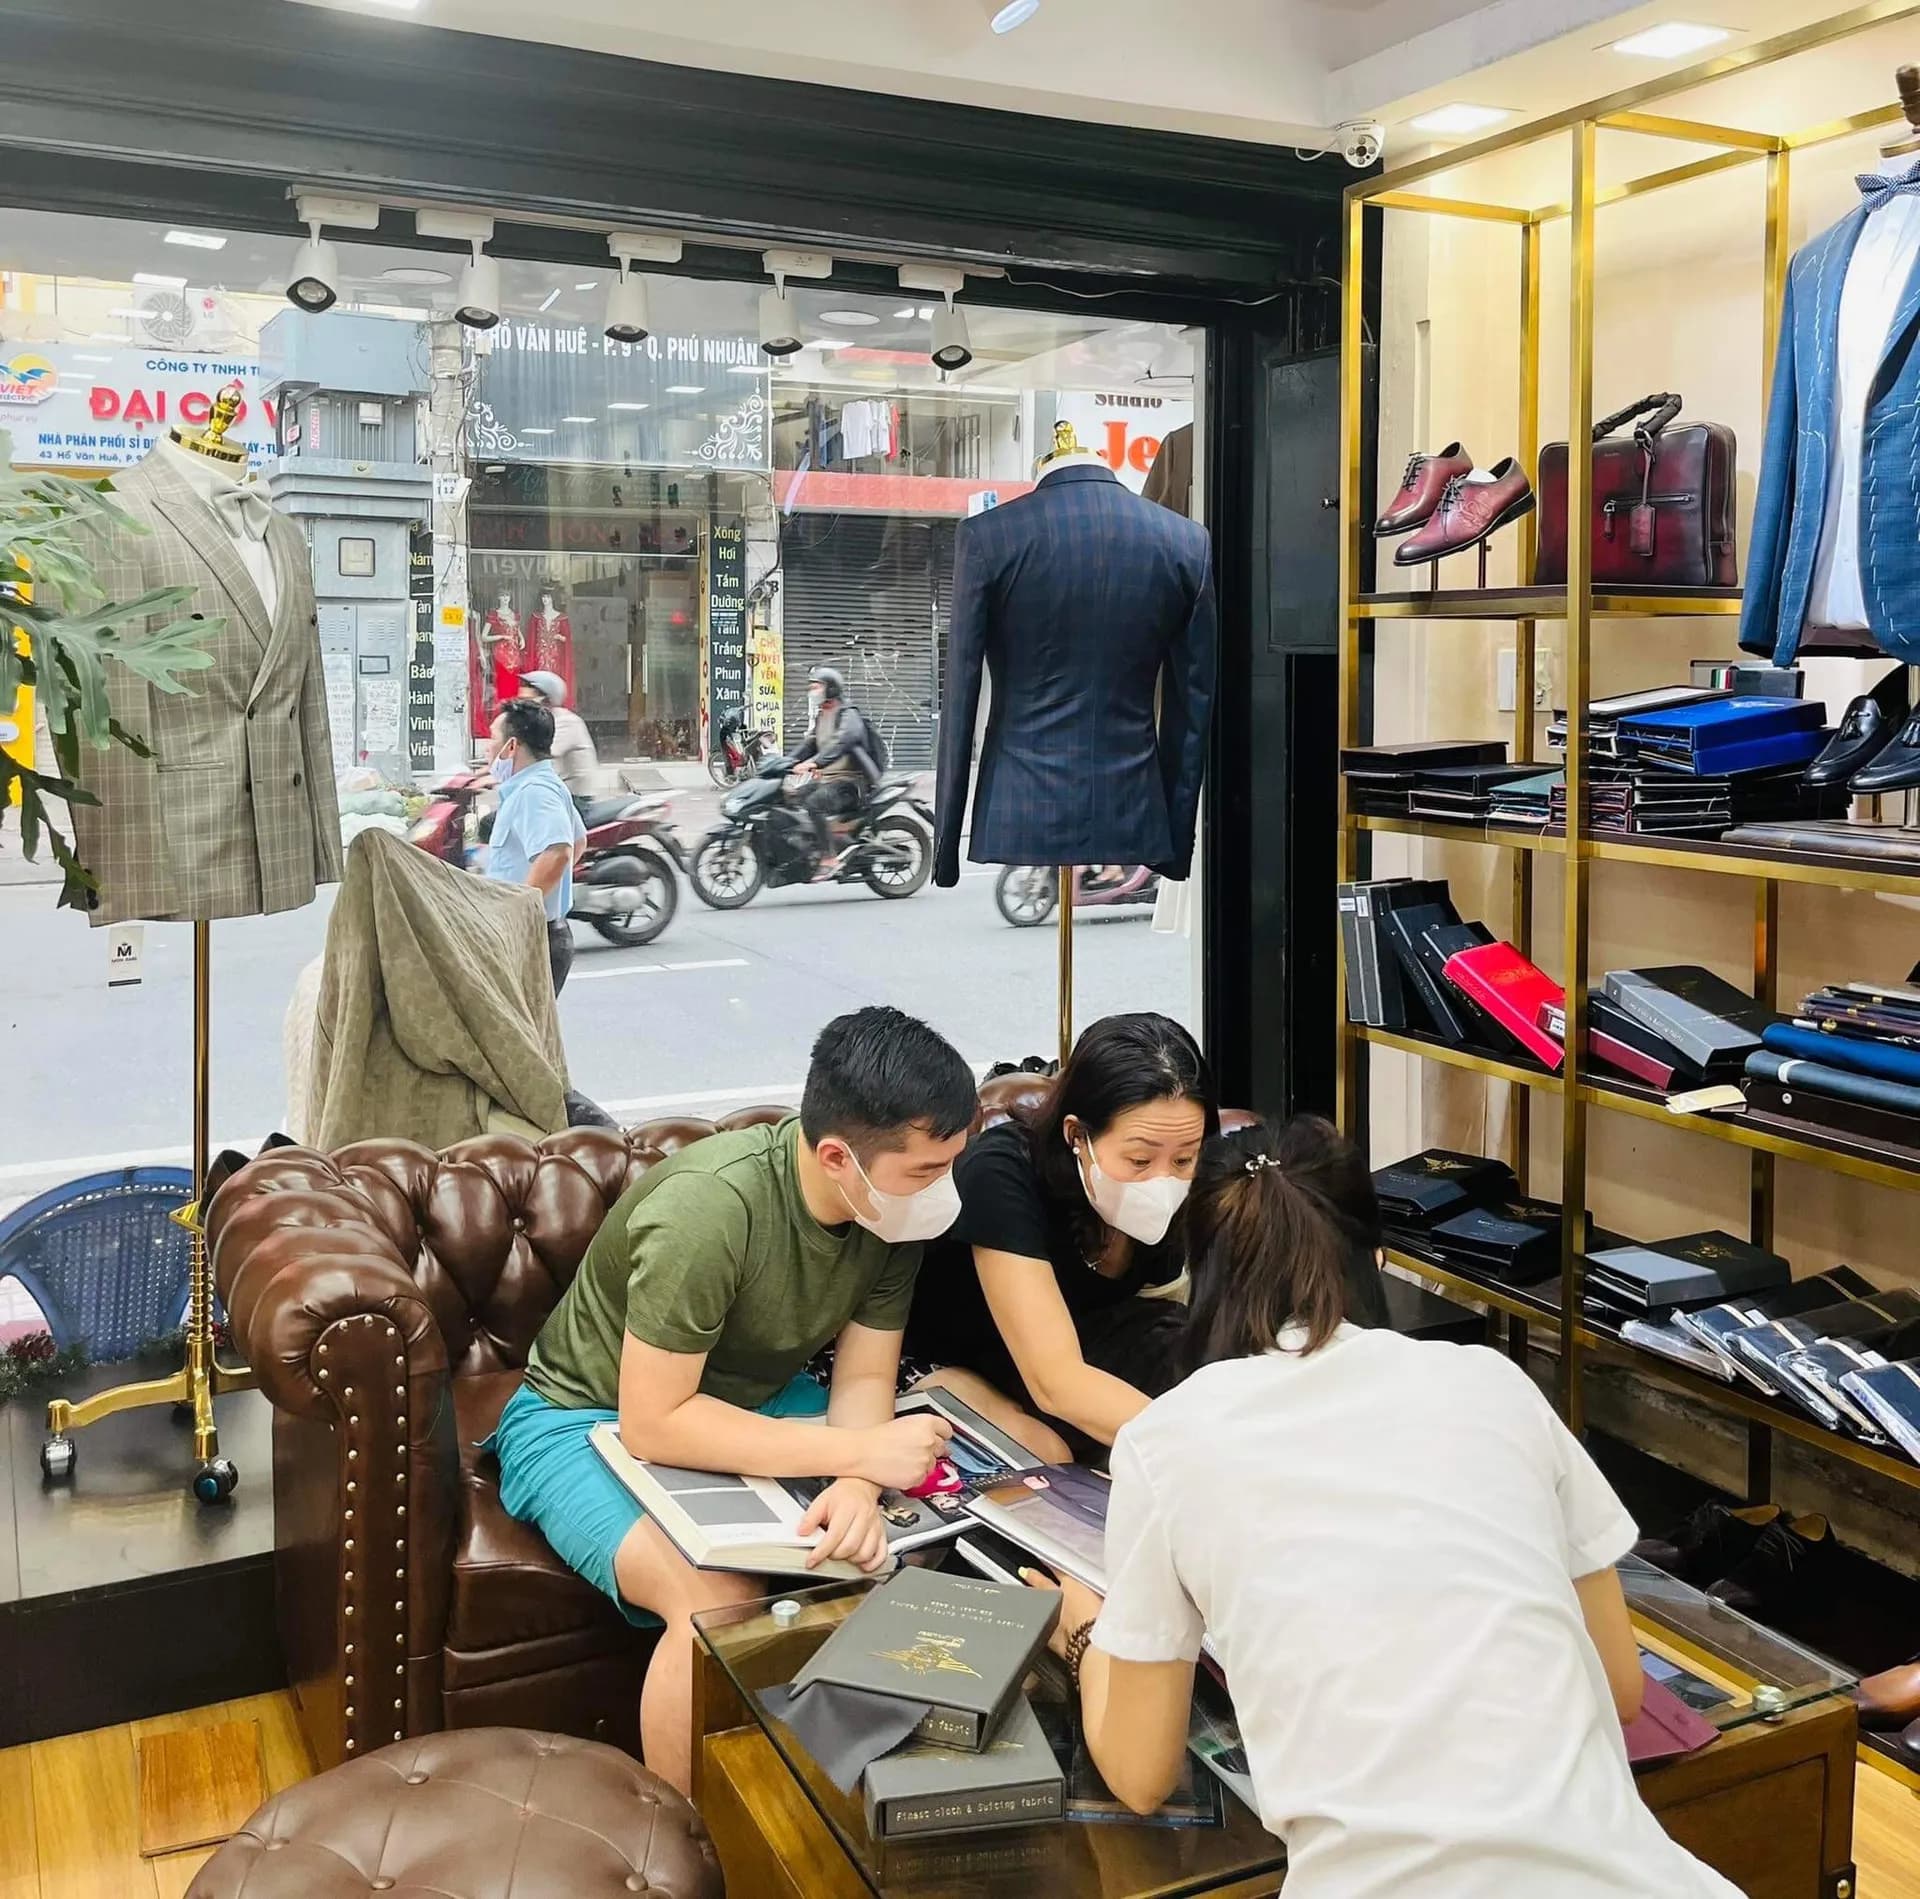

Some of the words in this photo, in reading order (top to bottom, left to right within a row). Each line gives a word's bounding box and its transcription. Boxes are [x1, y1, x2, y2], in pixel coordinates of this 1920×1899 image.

[515, 322, 550, 352] VĂN
[555, 326, 587, 354] HUÊ
[647, 335, 663, 362] Q.
[667, 333, 699, 361] PHÚ
[146, 358, 188, 373] CÔNG
[193, 363, 207, 374] TY
[212, 363, 247, 376] TNHH
[89, 386, 167, 431] ĐẠI
[38, 432, 62, 446] NHÀ
[65, 433, 97, 447] PHÂN
[719, 546, 736, 560] Hơi
[417, 600, 432, 614] àn
[715, 666, 741, 680] Phun
[896, 1809, 930, 1822] Finest
[934, 1804, 962, 1817] cloth
[1021, 1796, 1054, 1808] fabric
